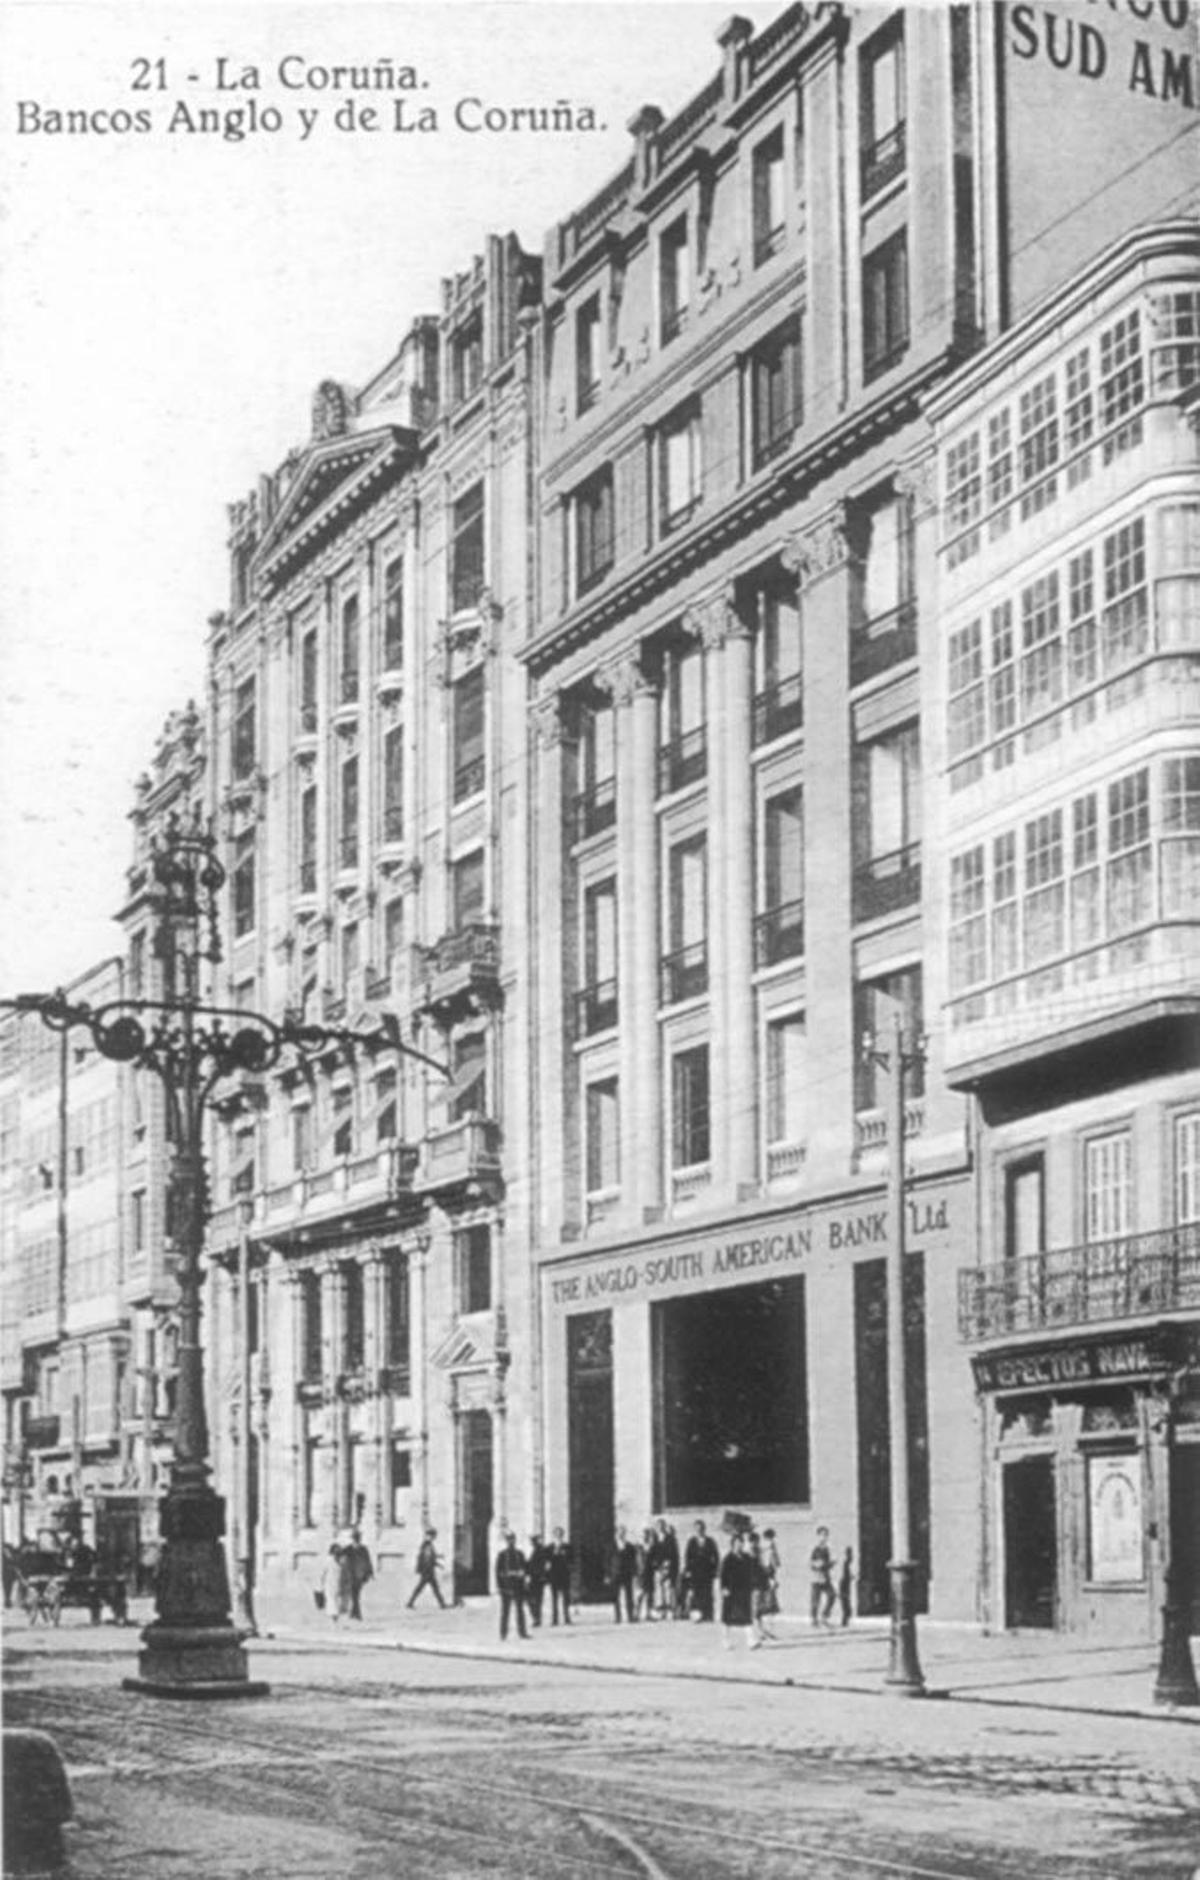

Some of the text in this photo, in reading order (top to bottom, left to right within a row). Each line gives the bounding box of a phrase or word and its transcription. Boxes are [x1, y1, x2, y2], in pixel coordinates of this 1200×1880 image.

[1010, 4, 1195, 110] SUD AM
[552, 1277, 580, 1304] THE
[712, 1230, 813, 1273] AMERICAN
[829, 1211, 888, 1250] BANK
